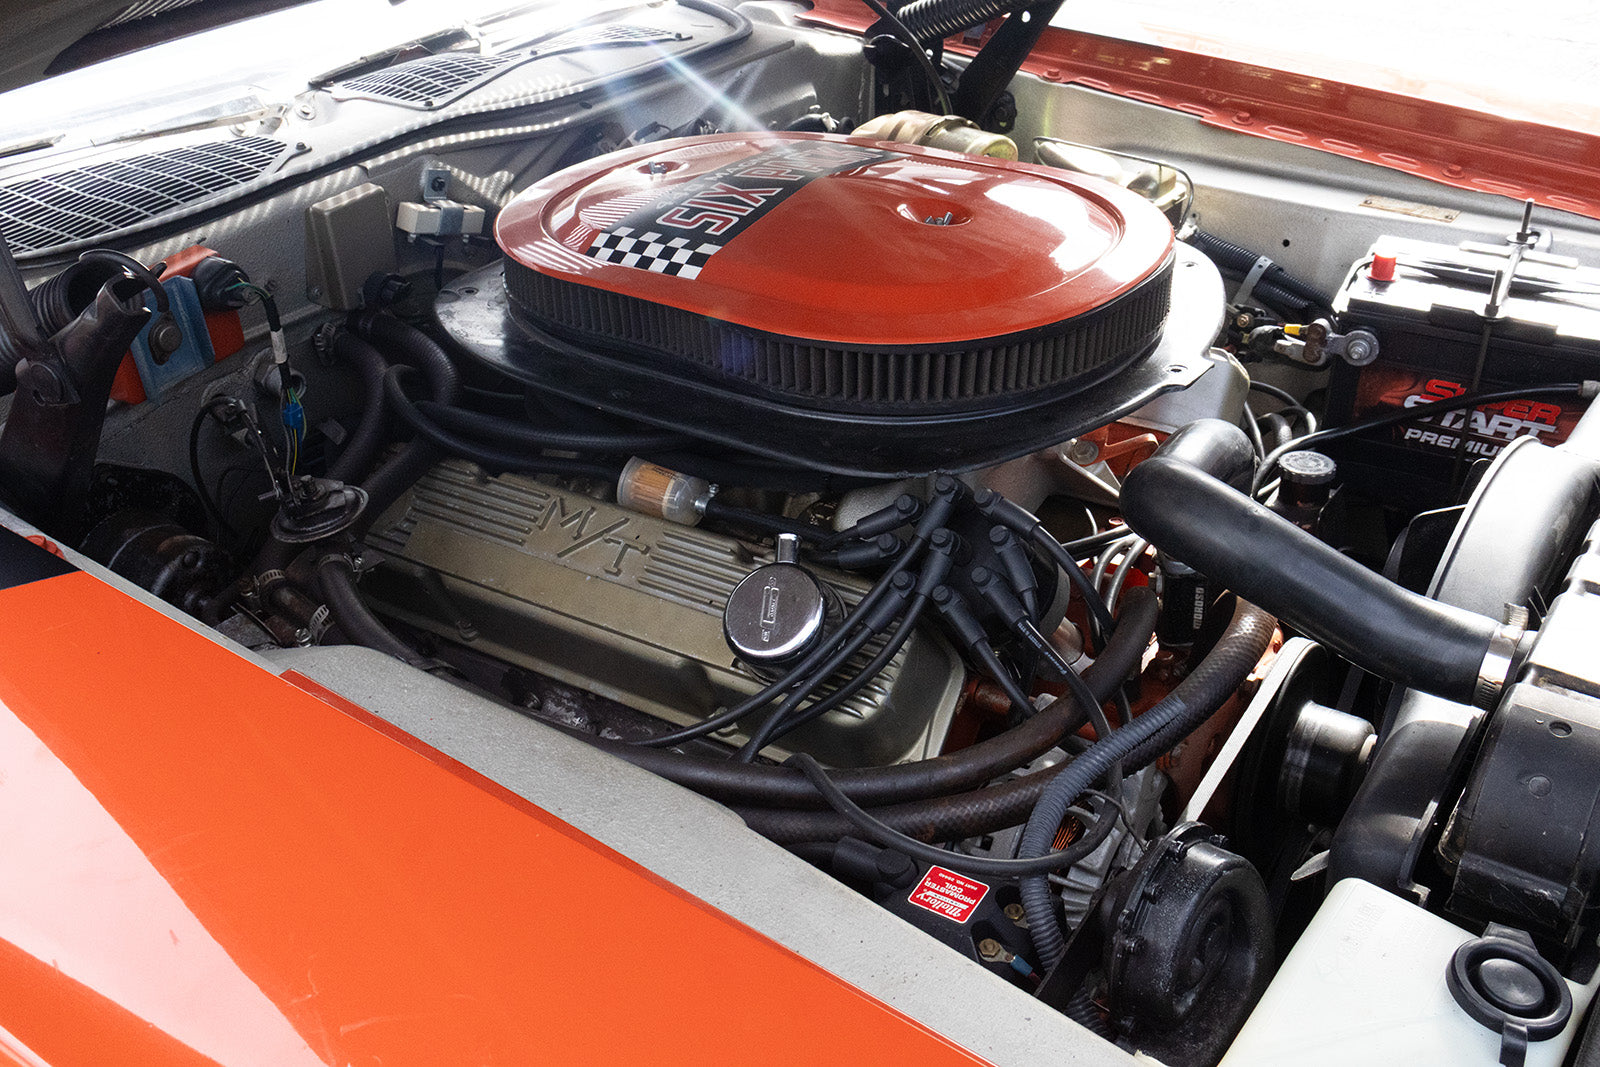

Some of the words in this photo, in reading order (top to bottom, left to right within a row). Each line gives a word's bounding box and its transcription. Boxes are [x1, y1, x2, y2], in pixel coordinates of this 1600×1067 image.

[656, 182, 783, 236] SIX
[1419, 379, 1562, 426] SER
[1403, 428, 1505, 457] PREMIU
[536, 496, 651, 577] M/T
[924, 880, 976, 905] PROMASTER
[945, 882, 963, 893] COIL
[915, 892, 963, 917] Mallory
